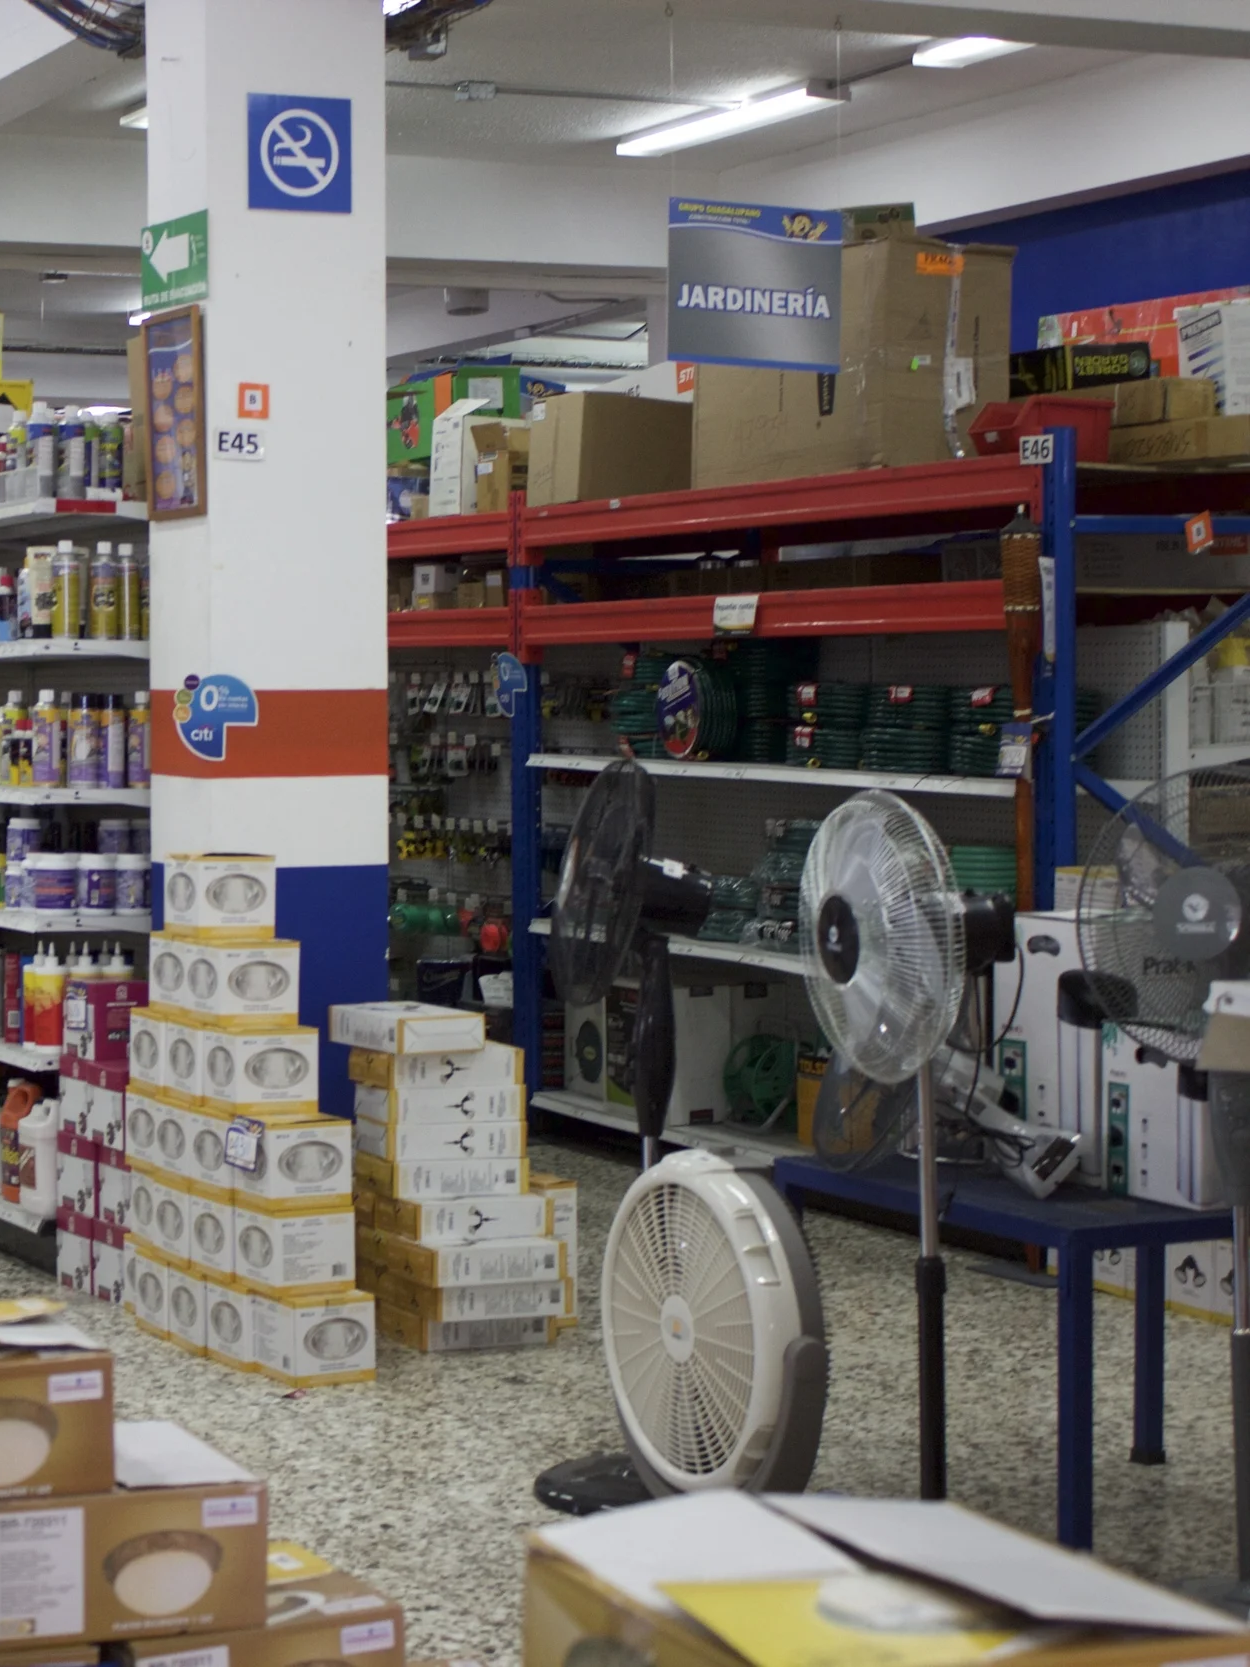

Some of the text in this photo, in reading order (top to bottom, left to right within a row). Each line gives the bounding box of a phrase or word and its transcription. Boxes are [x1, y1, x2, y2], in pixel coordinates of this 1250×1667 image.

[677, 283, 830, 319] JARDINERÍA
[218, 431, 260, 455] E45
[1021, 439, 1050, 459] E46
